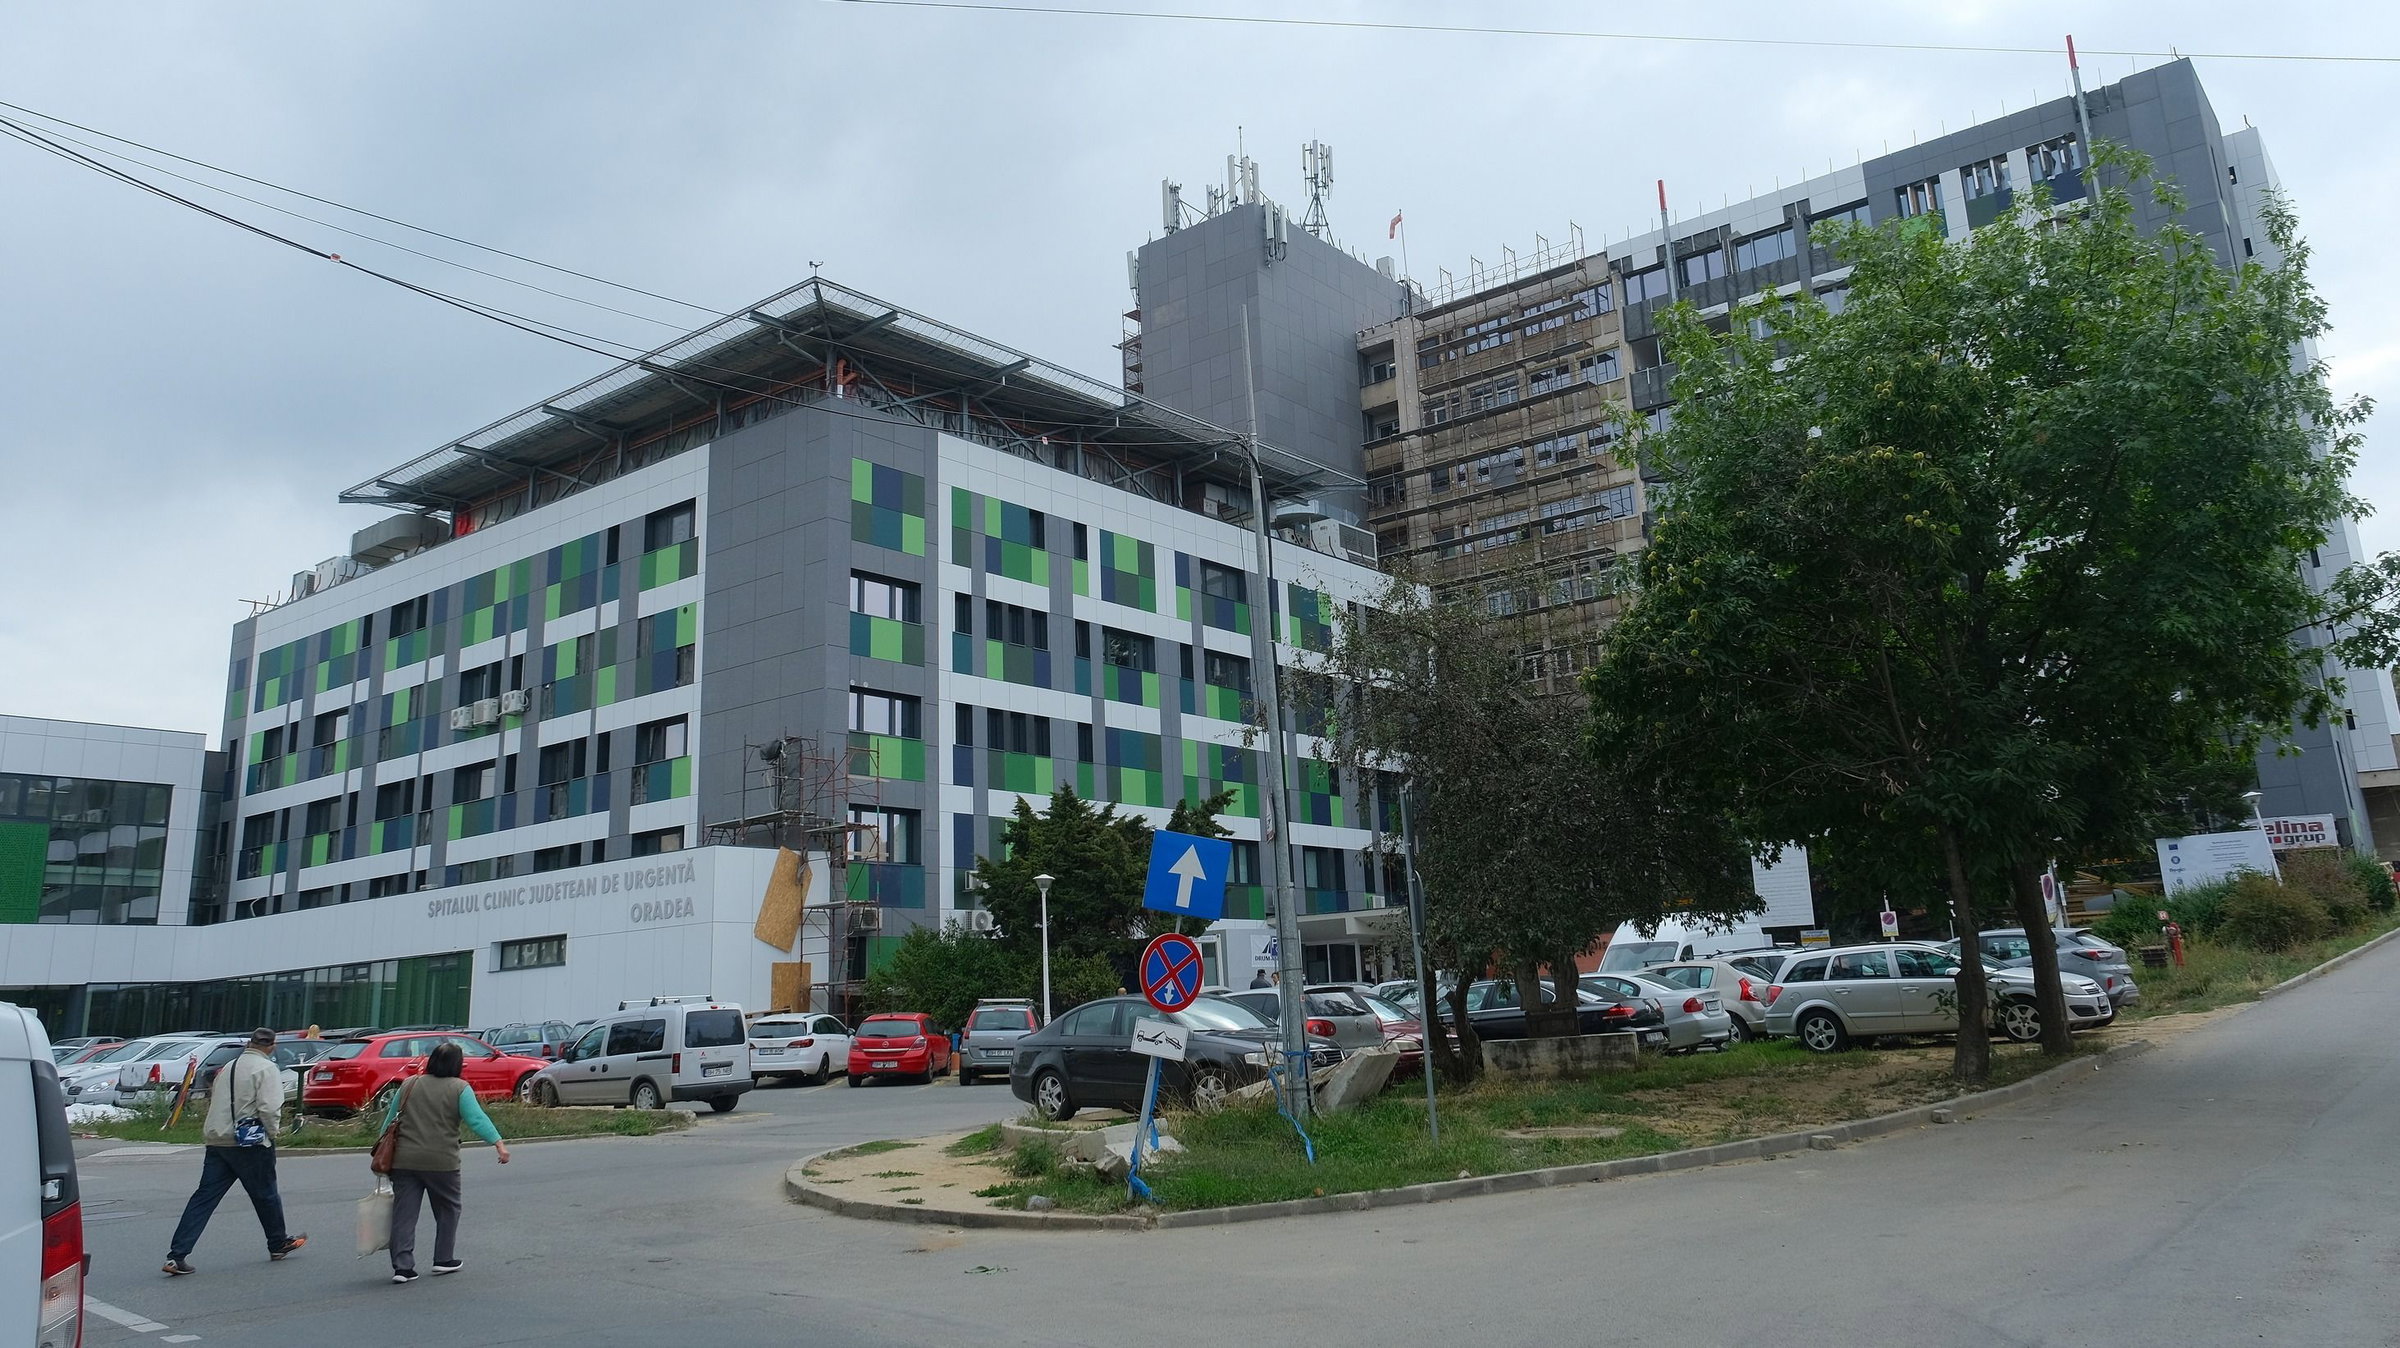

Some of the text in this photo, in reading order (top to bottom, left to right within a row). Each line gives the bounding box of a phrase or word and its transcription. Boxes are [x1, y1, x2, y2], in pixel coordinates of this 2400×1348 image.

[2263, 820, 2325, 835] elina
[2283, 833, 2326, 846] grup
[427, 894, 480, 918] SPITALUL
[483, 887, 526, 911] CLINIC
[600, 873, 620, 895] DE
[630, 897, 695, 923] ORADEA
